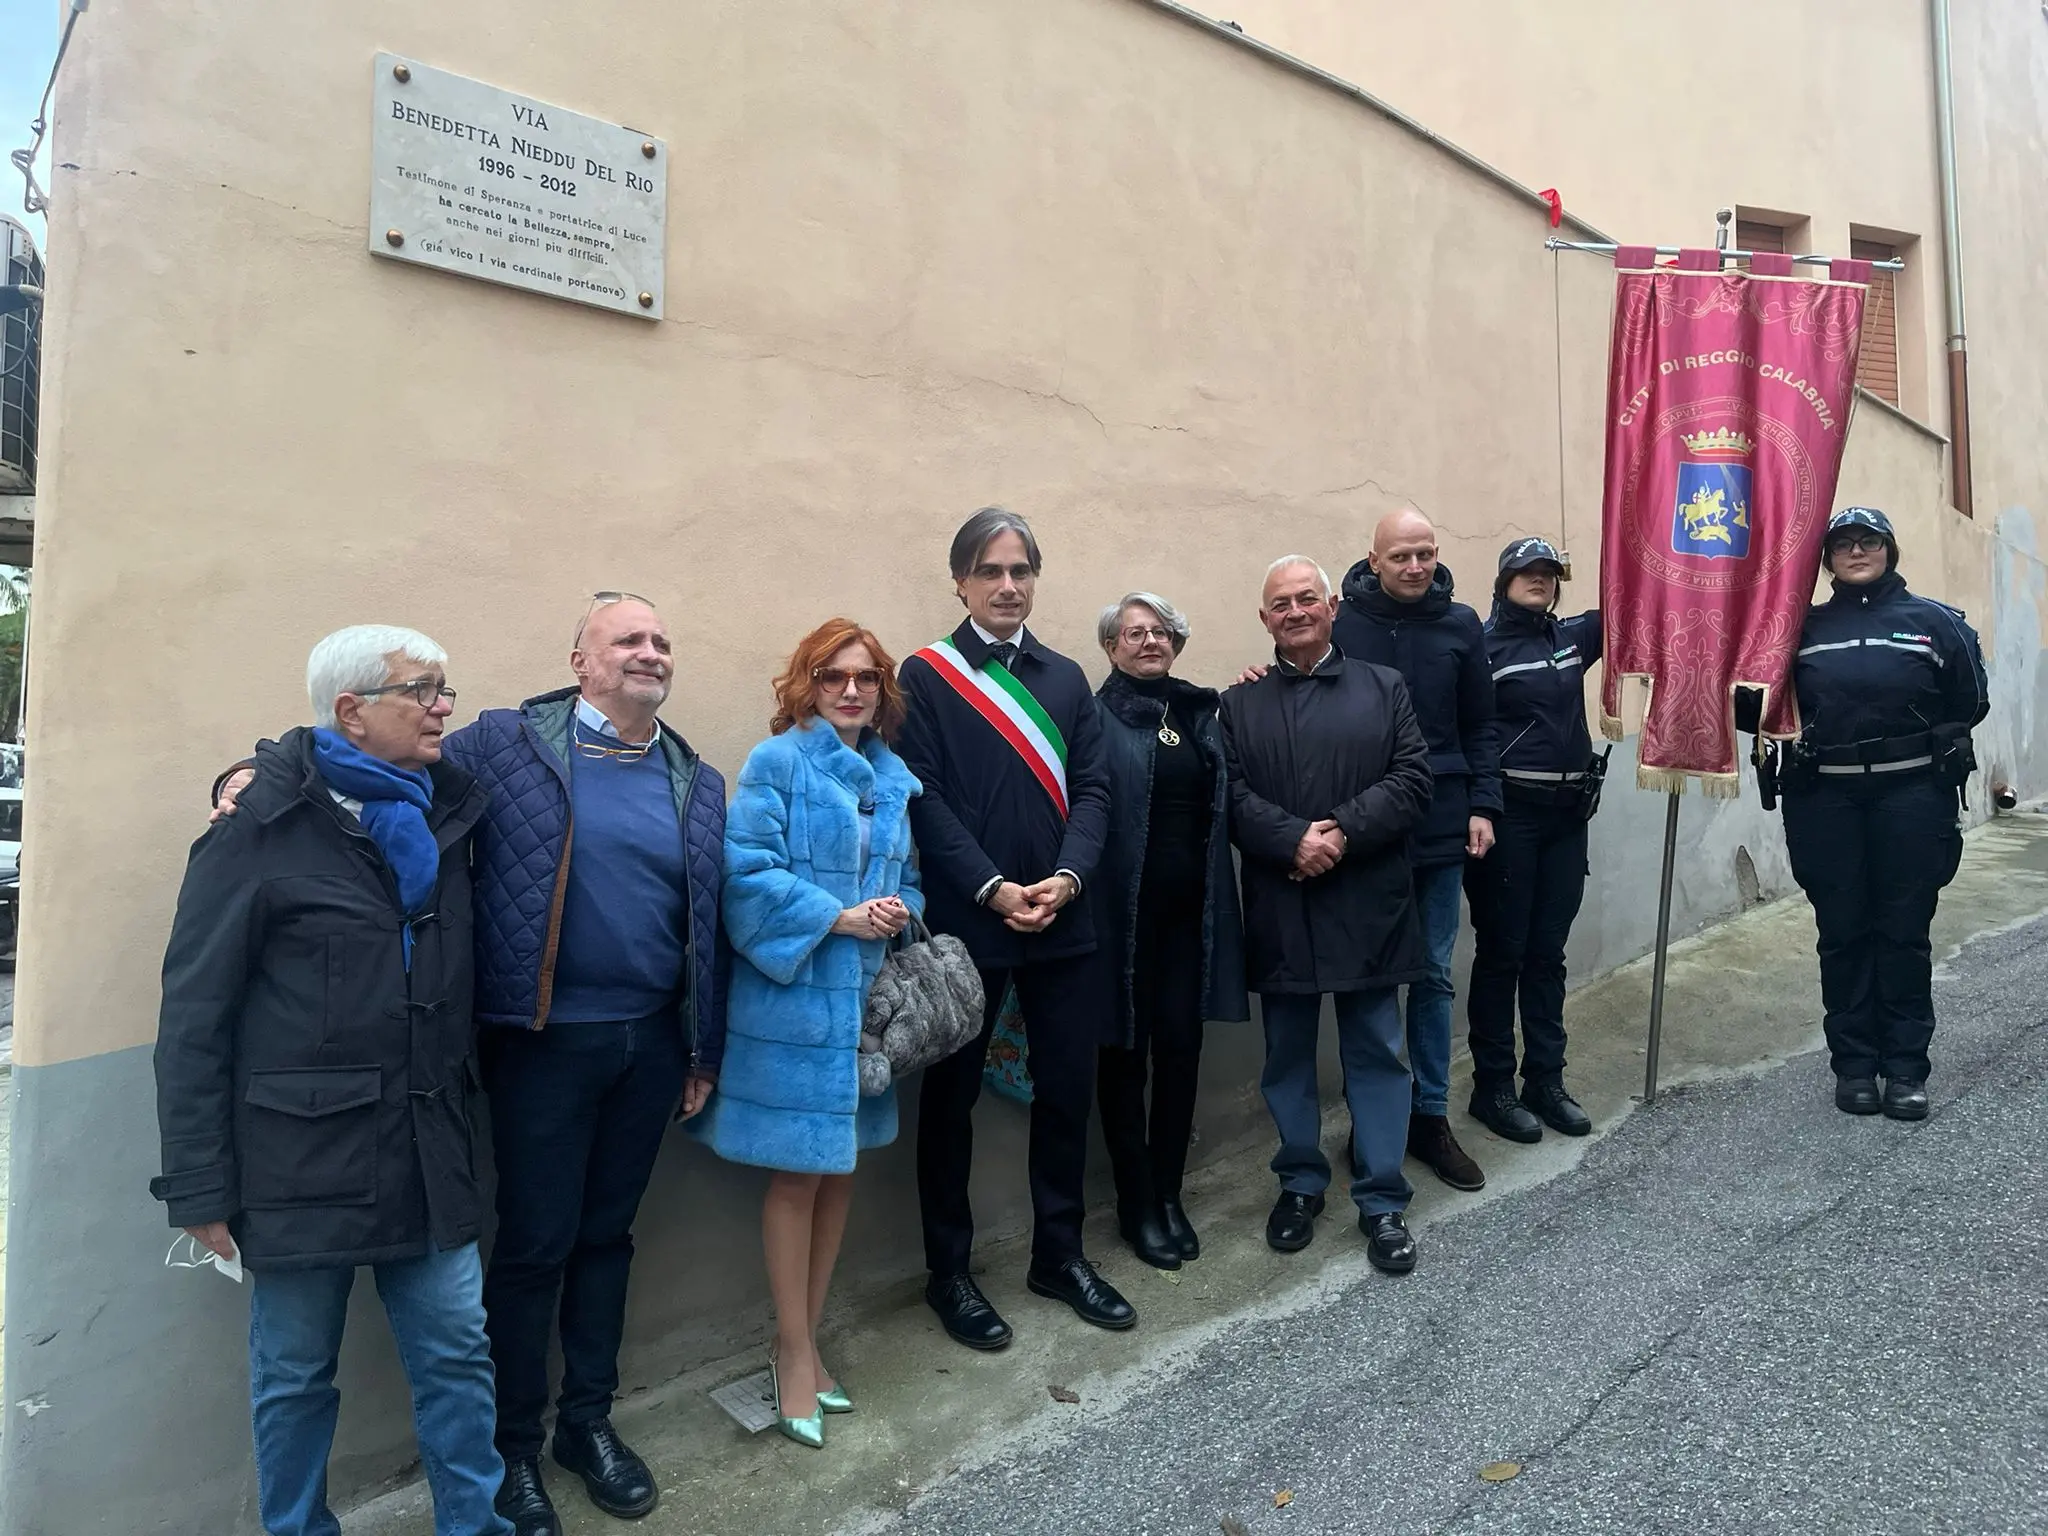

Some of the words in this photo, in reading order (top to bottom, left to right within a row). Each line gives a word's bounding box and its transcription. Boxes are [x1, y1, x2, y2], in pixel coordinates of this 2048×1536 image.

[511, 104, 549, 131] VIA
[391, 100, 501, 149] BENEDETTA
[511, 136, 576, 170] NIEDDU
[585, 158, 617, 183] DEL
[625, 171, 654, 194] RIO
[479, 156, 515, 179] 1996
[540, 174, 577, 197] 2012
[396, 165, 458, 192] Testimone
[463, 186, 475, 197] di
[480, 189, 532, 213] Speranza
[537, 207, 543, 215] e
[549, 210, 603, 232] portatrice
[608, 226, 618, 237] di
[623, 229, 647, 243] Luce
[439, 195, 453, 208] ha
[459, 203, 502, 220] cercato
[508, 213, 518, 225] la
[446, 216, 480, 232] anche
[485, 227, 503, 238] nei
[508, 231, 540, 248] giorni
[567, 247, 608, 266] difficili.
[450, 247, 473, 260] vico
[490, 257, 507, 269] via
[512, 264, 563, 283] cardinale
[568, 277, 626, 300] portanova)
[1659, 358, 1680, 376] DI
[1685, 350, 1755, 369] REGGIO
[1759, 364, 1835, 430] CALABRIA
